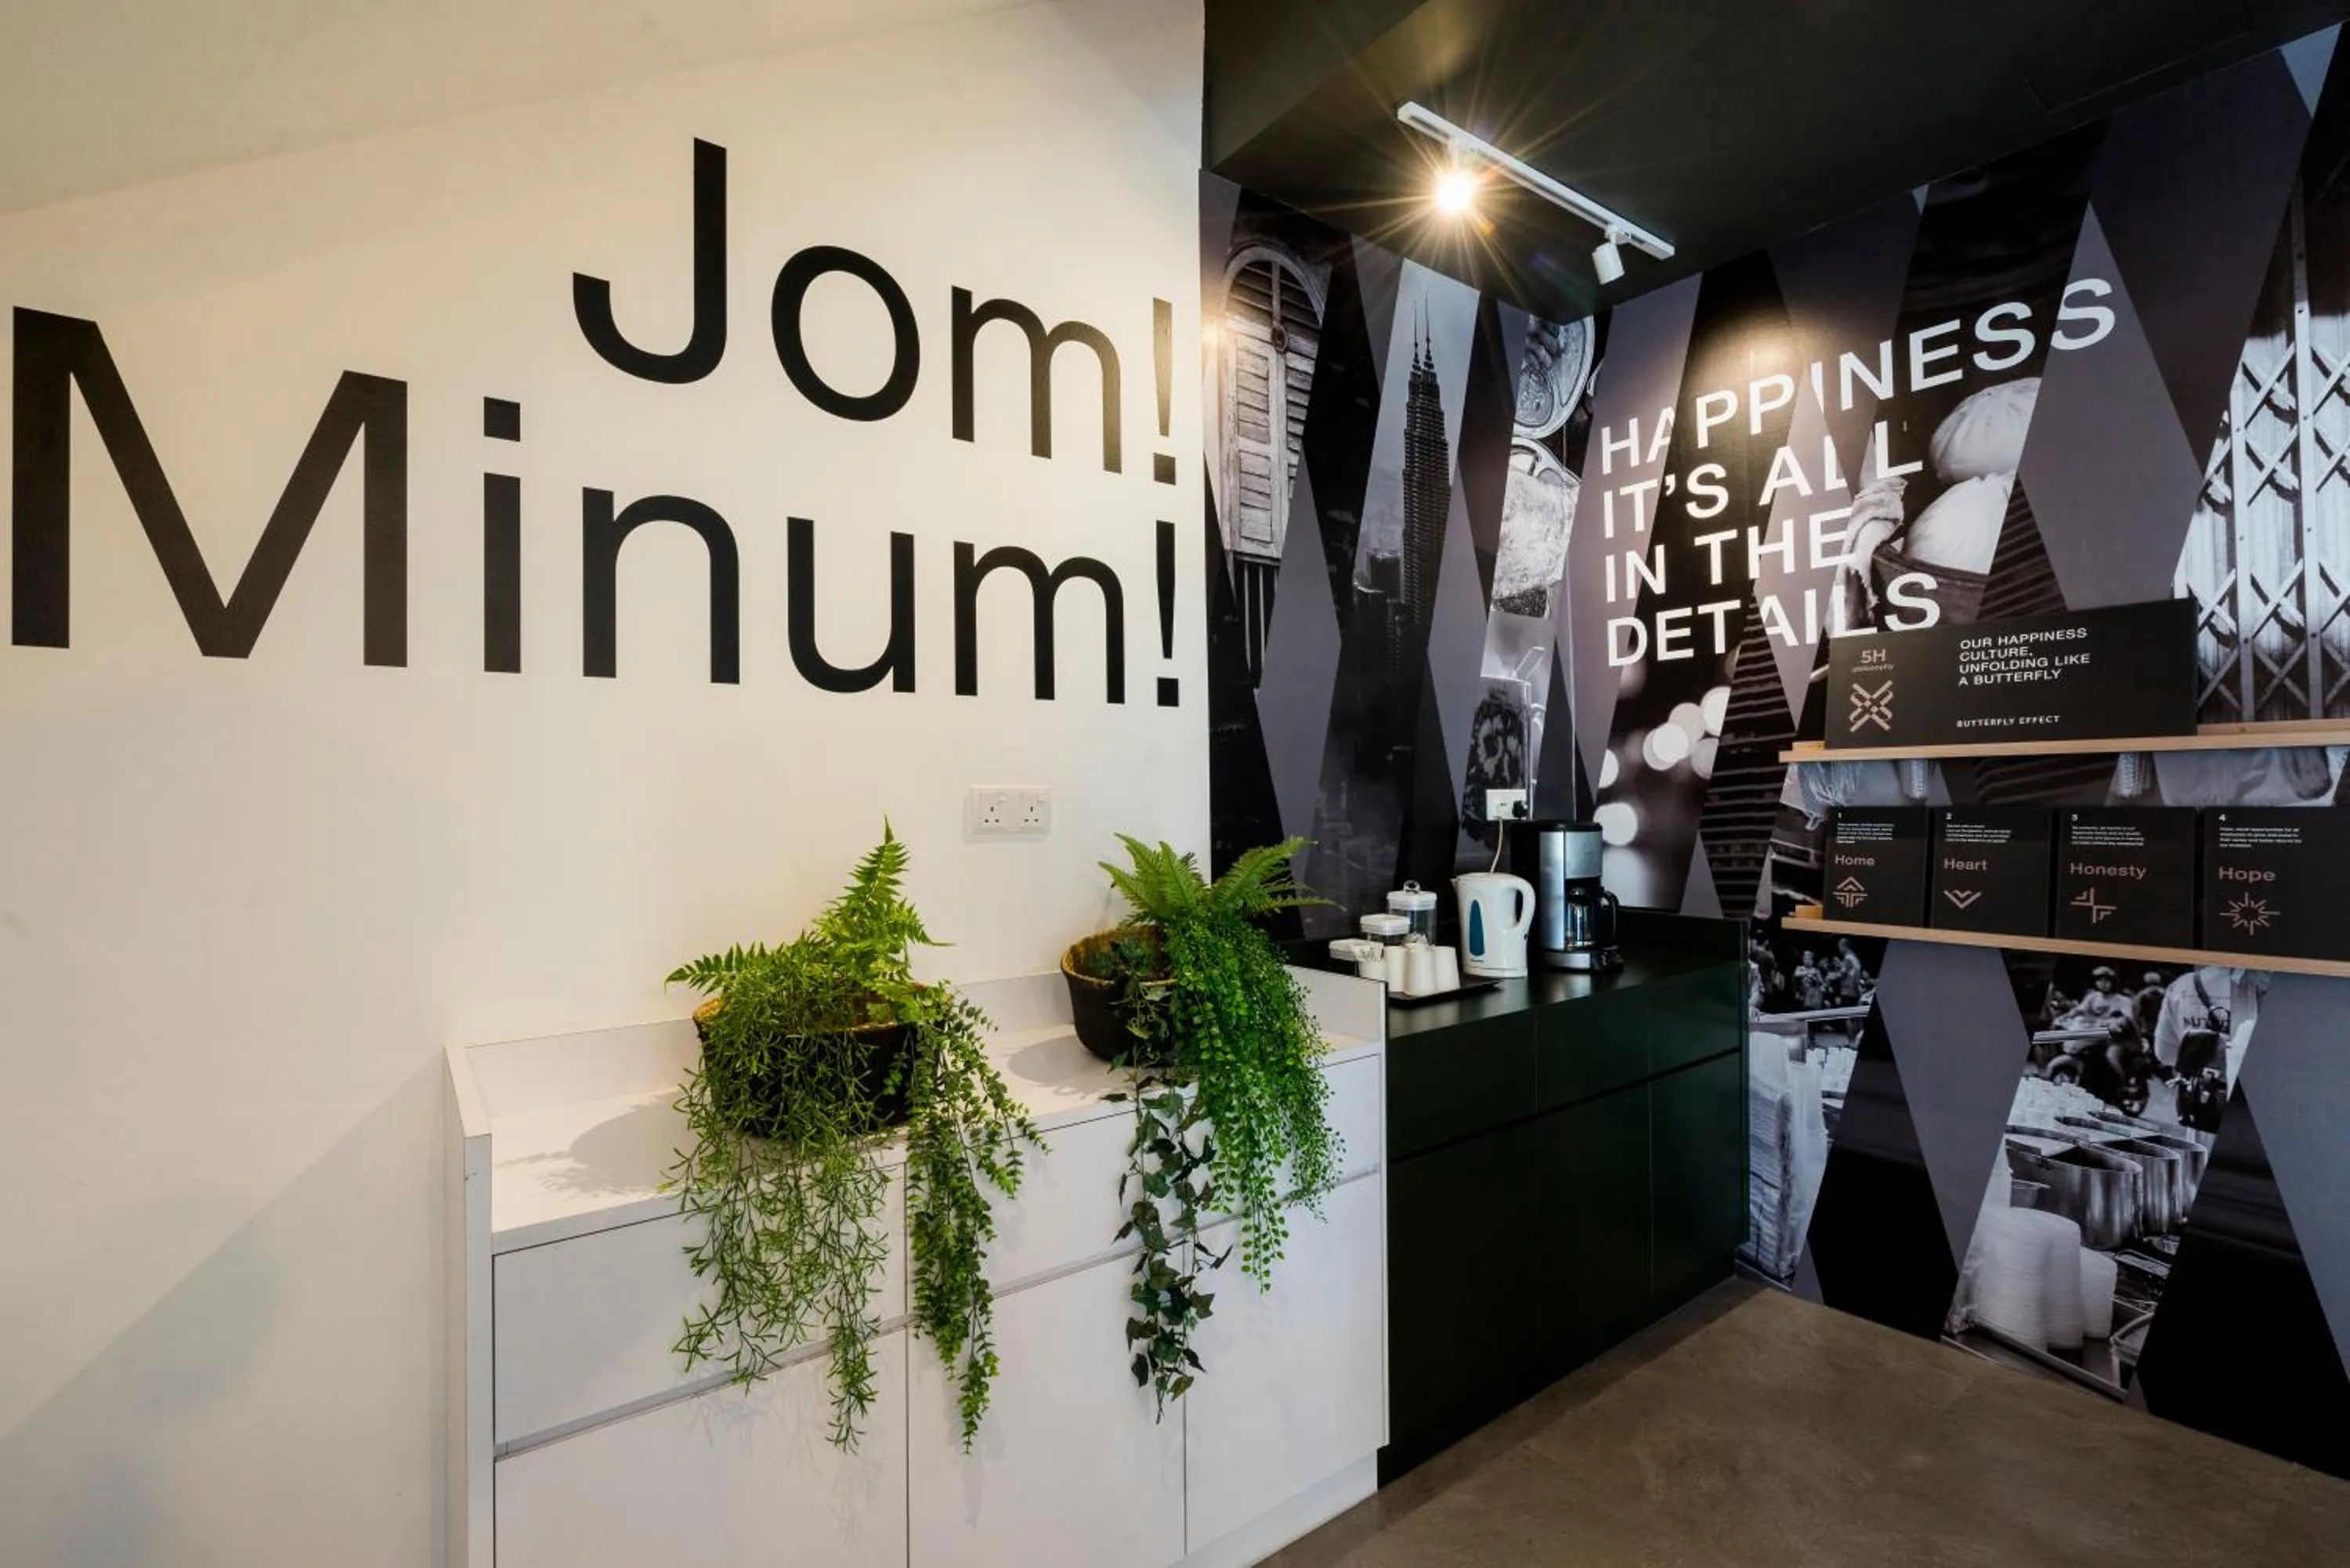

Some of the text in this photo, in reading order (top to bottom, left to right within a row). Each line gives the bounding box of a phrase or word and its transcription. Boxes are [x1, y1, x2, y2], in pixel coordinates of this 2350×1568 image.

[572, 137, 1177, 486] Jom!
[1600, 277, 2116, 475] HAPPINESS
[1603, 421, 1923, 539] IT'S ALL
[12, 305, 1180, 707] Minum!
[1605, 508, 1854, 602] IN THE
[1607, 573, 1941, 667] DETAILS
[1961, 627, 2088, 649] OUR HAPPINESS
[1860, 648, 1886, 664] 5H
[1959, 653, 2091, 674] UNFOLDING LIKE
[1958, 669, 2061, 687] A BUTTERFLY
[1956, 715, 2061, 728] BUTTERFLY EFFECT
[1835, 854, 1875, 867] Home
[1943, 858, 1988, 871] Heart
[2070, 862, 2146, 880] Honesty
[2218, 867, 2276, 884] Hope
